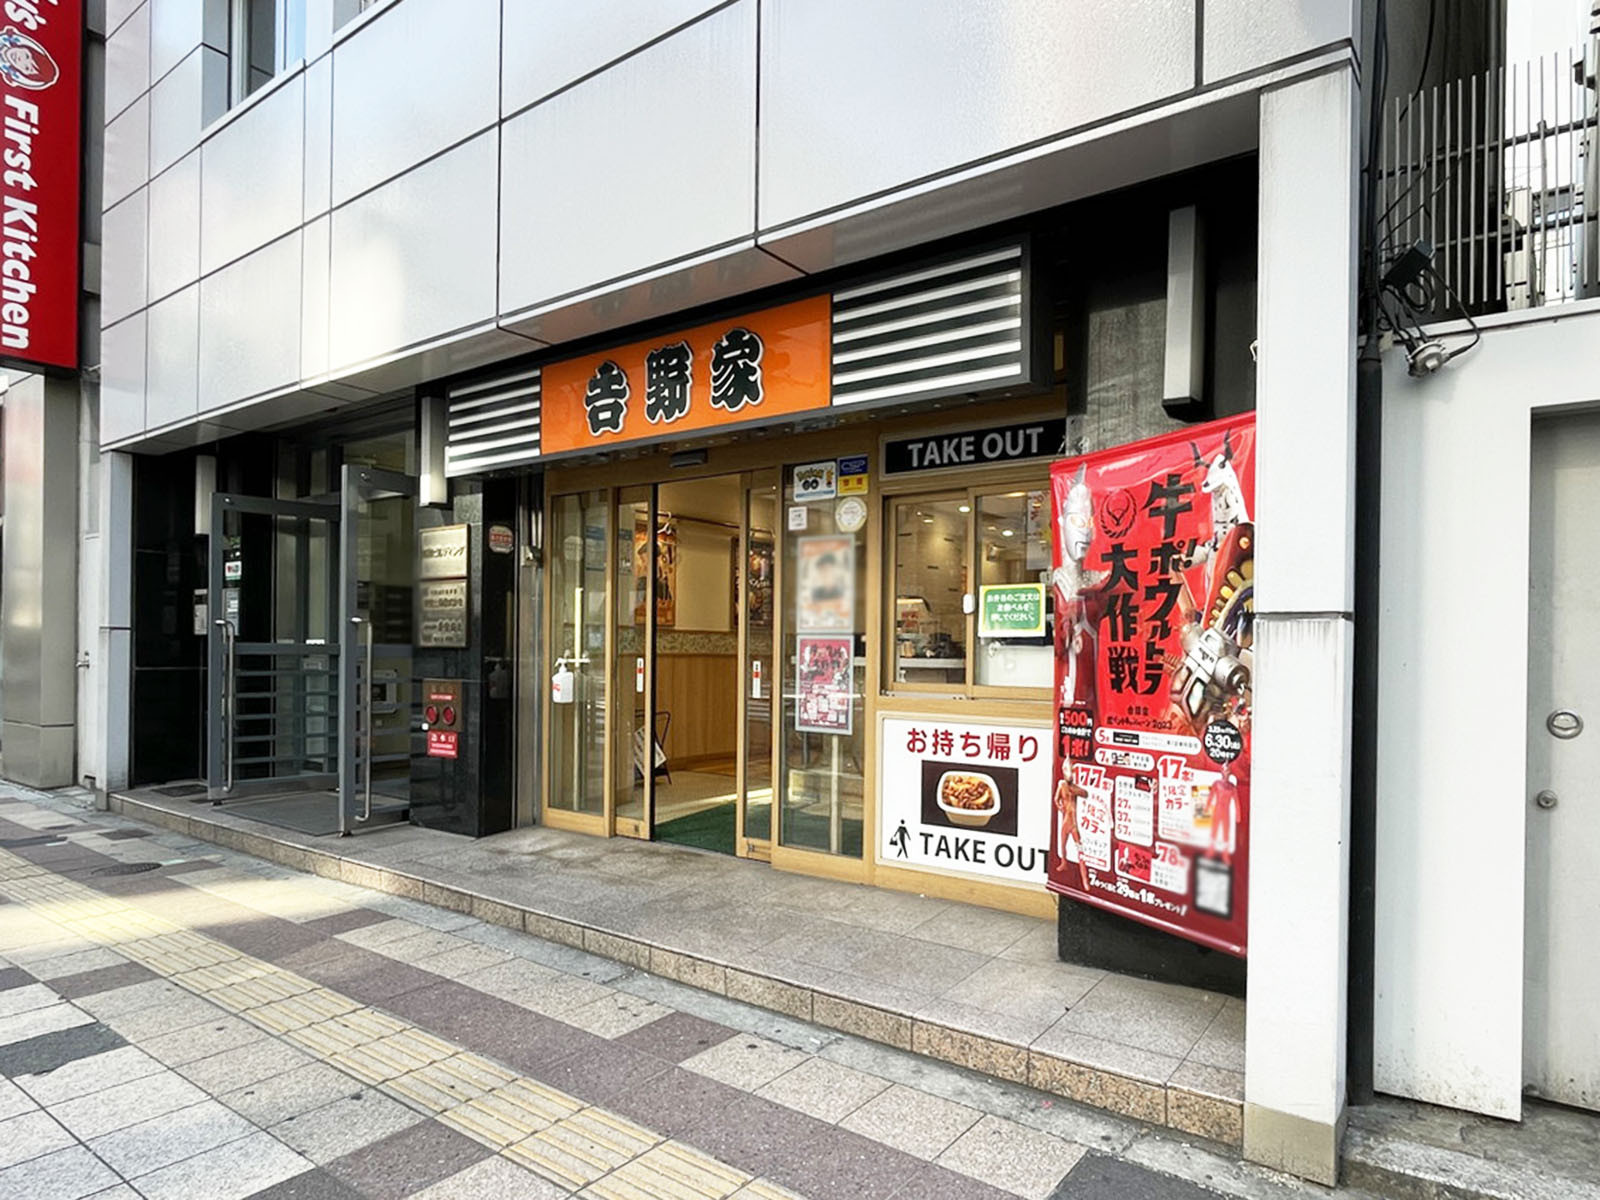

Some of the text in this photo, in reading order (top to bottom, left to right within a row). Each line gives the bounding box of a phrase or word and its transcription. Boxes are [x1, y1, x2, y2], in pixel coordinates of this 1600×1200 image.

[1, 95, 39, 350] First Kitchen
[907, 427, 1044, 468] TAKE OUT
[1100, 544, 1138, 694] 大作戦
[907, 728, 1039, 763] お持ち帰り
[1165, 798, 1189, 810] カラー
[1081, 816, 1106, 834] カラー
[919, 832, 1049, 874] TAKE OUT
